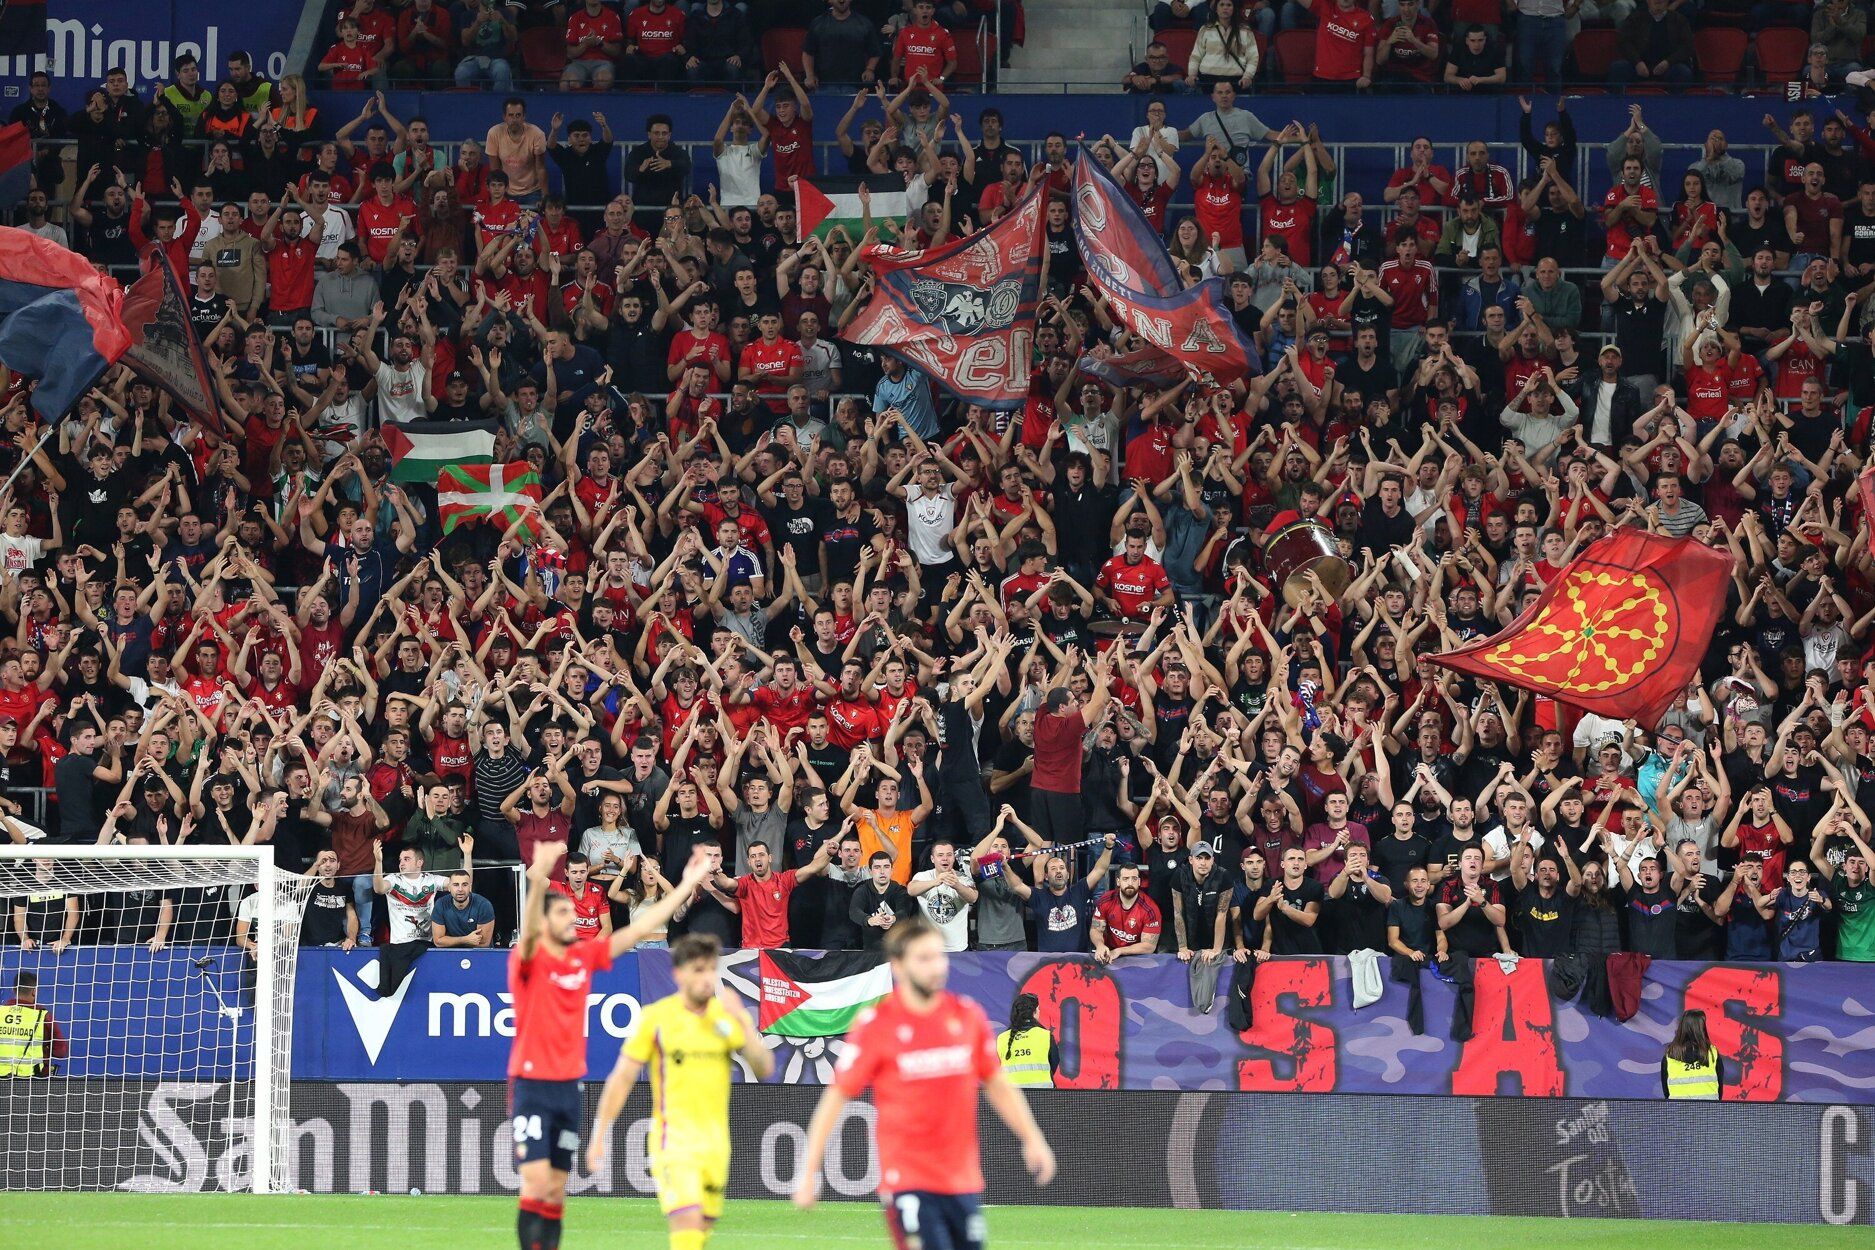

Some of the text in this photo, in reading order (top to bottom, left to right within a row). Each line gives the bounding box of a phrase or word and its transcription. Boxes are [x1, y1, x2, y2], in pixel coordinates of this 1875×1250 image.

[641, 29, 674, 40] kosner
[1327, 21, 1360, 40] kosner
[907, 45, 936, 55] kosner
[1206, 191, 1230, 204] kosner
[1270, 216, 1295, 227] kosner
[1789, 358, 1815, 370] CAN
[1694, 391, 1722, 400] verleal
[1114, 582, 1146, 593] kosner
[830, 709, 861, 730] kosner
[440, 755, 468, 765] kosner
[1109, 926, 1137, 941] kosner
[0, 1026, 34, 1038] EGURIDAD
[1014, 1048, 1032, 1058] 236
[1683, 1061, 1702, 1072] 248
[513, 1114, 543, 1142] 24
